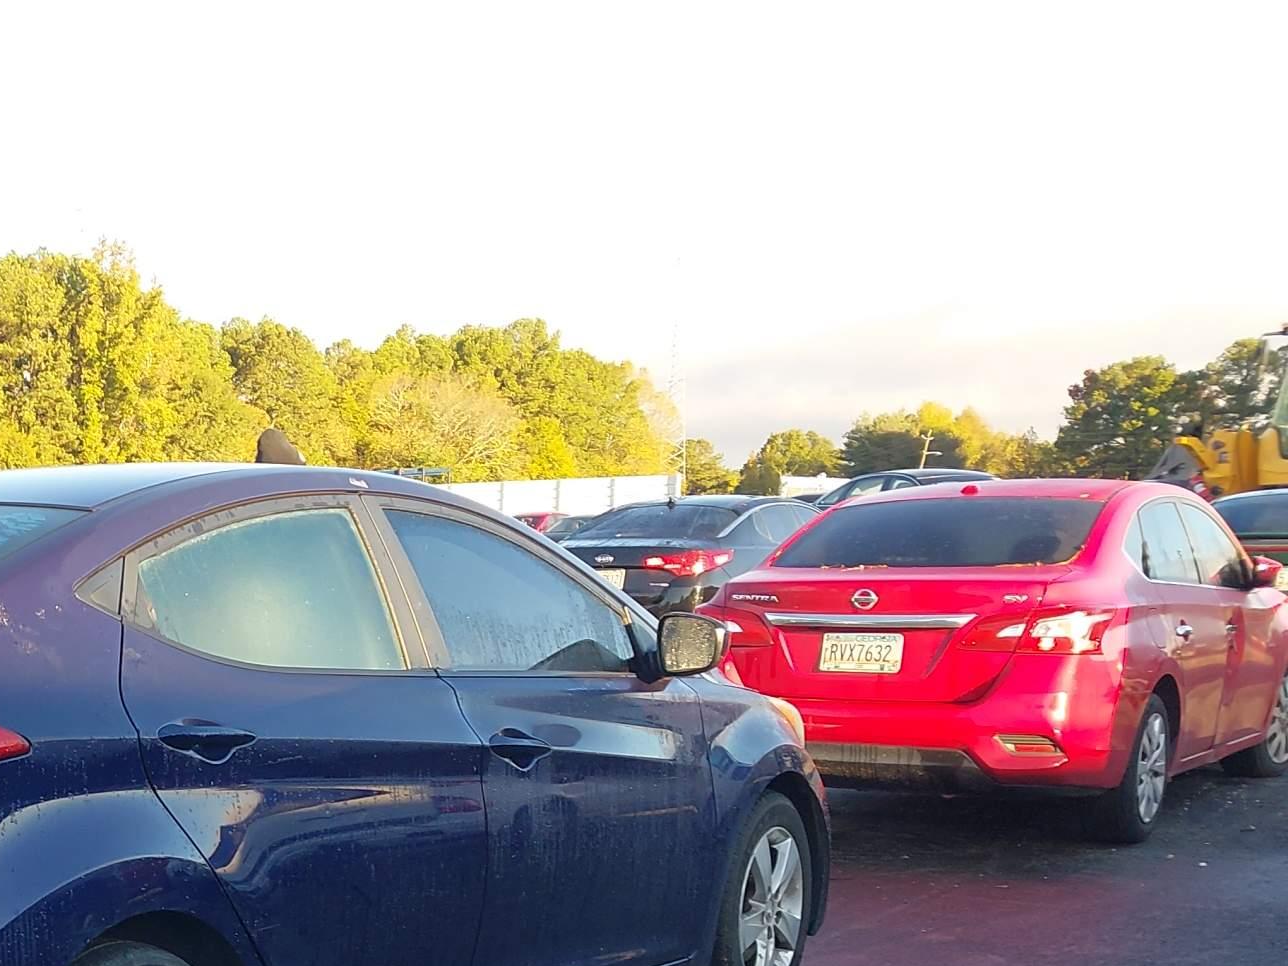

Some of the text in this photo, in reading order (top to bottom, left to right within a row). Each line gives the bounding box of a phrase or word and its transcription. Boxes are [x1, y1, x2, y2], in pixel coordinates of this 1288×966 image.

[731, 594, 779, 603] SENTRA
[1003, 594, 1028, 603] SV
[830, 643, 892, 663] RVX7632
